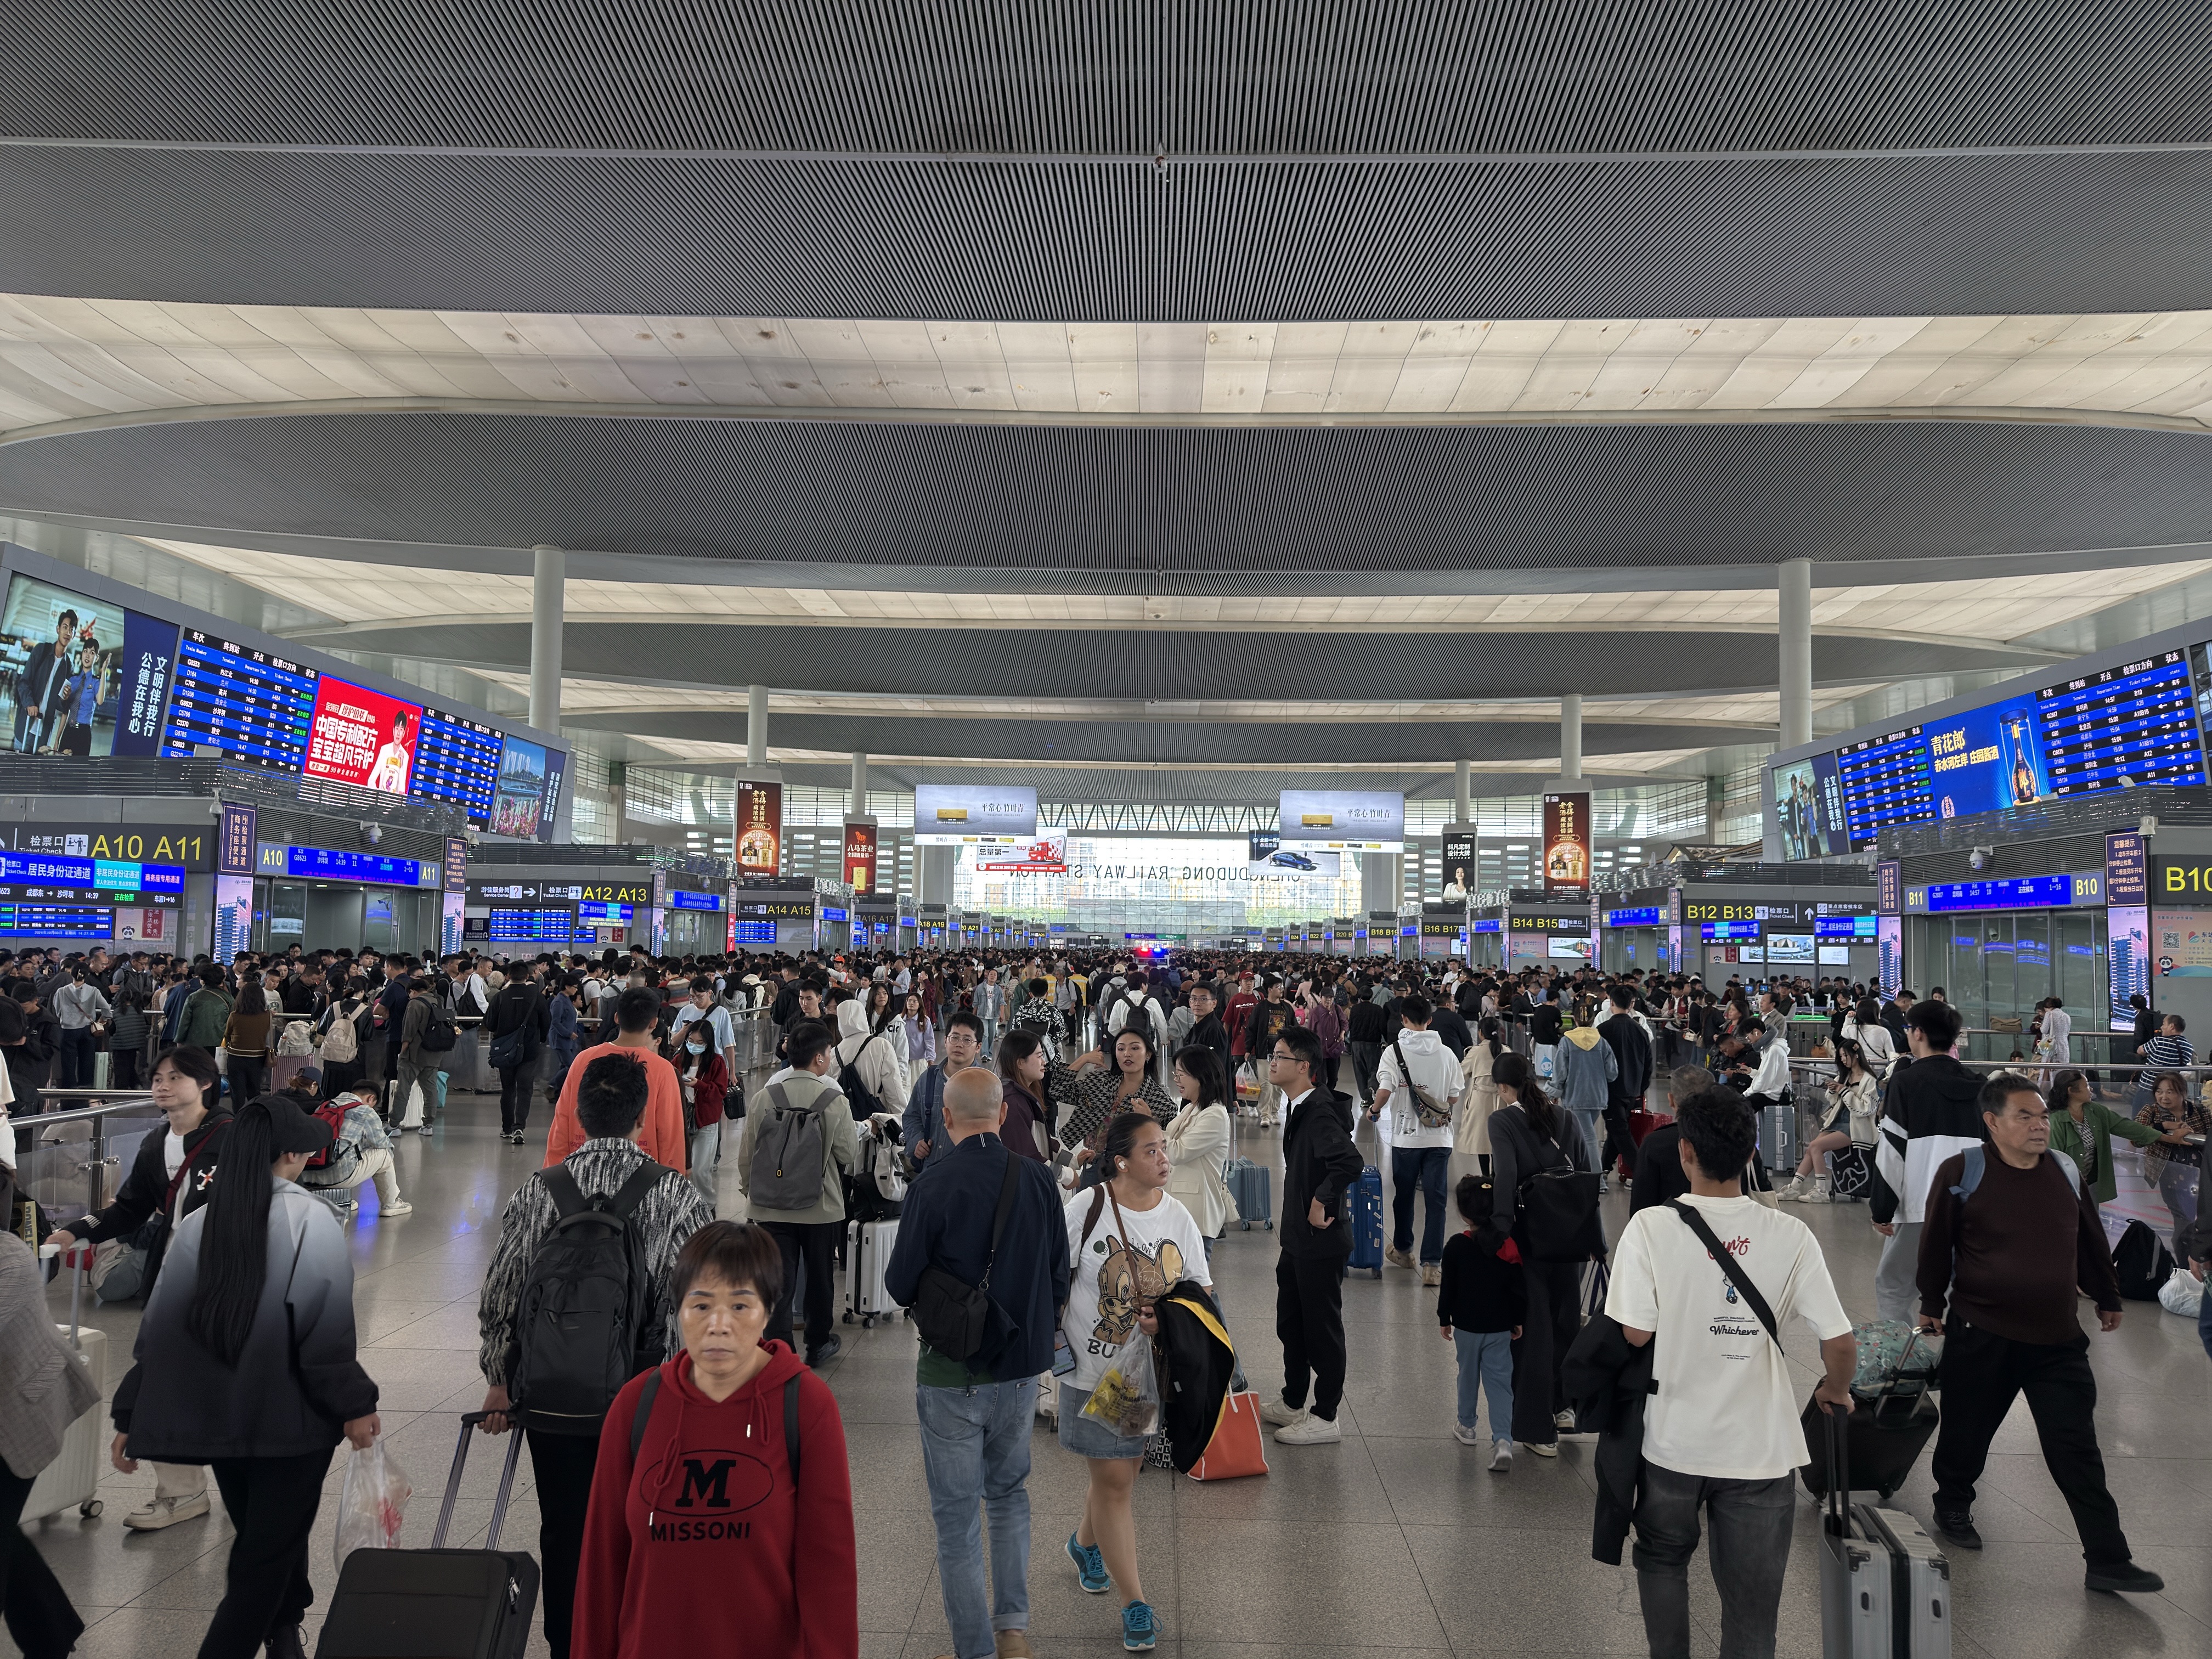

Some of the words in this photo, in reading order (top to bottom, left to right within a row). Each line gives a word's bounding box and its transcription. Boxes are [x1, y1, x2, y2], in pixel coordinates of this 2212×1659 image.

[193, 631, 204, 643] 车次
[223, 642, 240, 654] 终到站
[253, 652, 264, 662] 开点
[273, 658, 296, 672] 检票口方向
[306, 669, 315, 678] 状态
[2042, 689, 2053, 698] 车次
[2069, 679, 2085, 690] 终到站
[2100, 672, 2112, 682] 开点
[2123, 659, 2152, 675] 检票口方向
[2165, 652, 2179, 663] 状态
[128, 652, 153, 733] 公德在我心
[144, 656, 167, 737] 文明伴我行
[315, 714, 378, 749] 中国专利配方
[1931, 730, 1965, 756] 青花郎
[311, 737, 374, 769] 宝宝超凡守护
[1934, 752, 1968, 773] 赤水河左岸
[1970, 745, 1999, 764] 庄园酱酒
[30, 835, 64, 847] 检票口
[91, 834, 143, 859] A10
[153, 836, 200, 860] A11
[848, 844, 873, 853] 八马茶业
[2114, 839, 2135, 849] 温馨提示
[263, 849, 283, 866] A10
[28, 863, 91, 879] 居民身份证通道
[97, 868, 139, 879] 非居民身份证通道
[145, 873, 180, 884] 商务座专用通道
[422, 867, 435, 881] A11
[26, 889, 44, 897] 成都东
[57, 890, 74, 899] 沙坪坝
[583, 887, 612, 900] A12
[617, 888, 647, 901] A13
[2076, 878, 2097, 896] B10
[1909, 891, 1923, 906] B11
[768, 905, 787, 915] A14
[791, 906, 810, 915] A15
[1688, 905, 1717, 919] B12
[1724, 906, 1753, 919] B13
[1513, 918, 1533, 927] B14
[1537, 918, 1558, 928] B15
[1137, 1243, 1152, 1256] LOVE
[1709, 1325, 1759, 1335] Whichever
[675, 1459, 736, 1507] M
[650, 1522, 751, 1542] MISSONI
